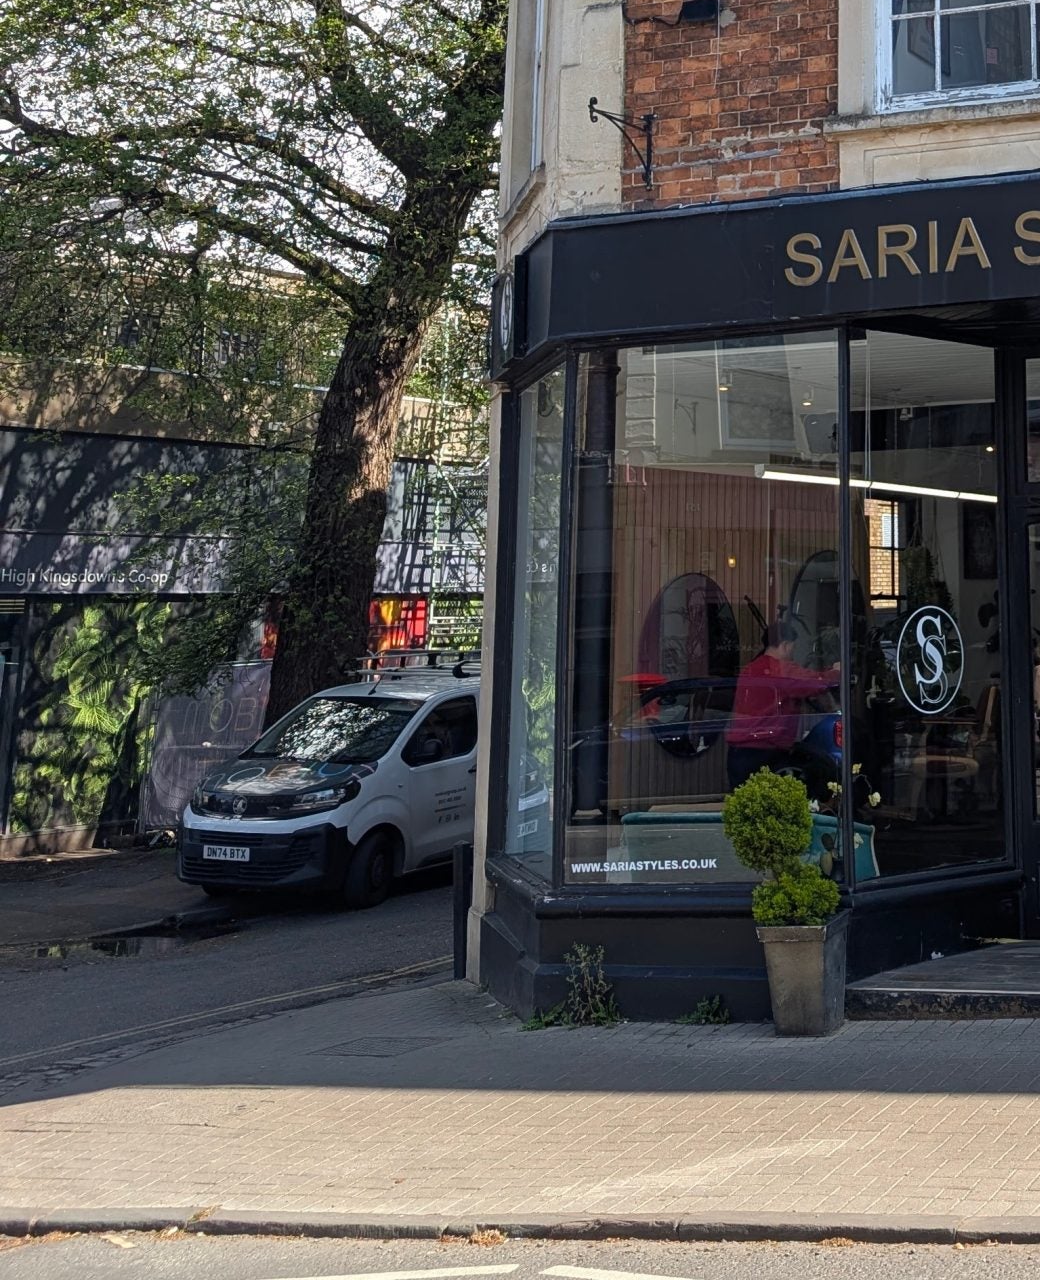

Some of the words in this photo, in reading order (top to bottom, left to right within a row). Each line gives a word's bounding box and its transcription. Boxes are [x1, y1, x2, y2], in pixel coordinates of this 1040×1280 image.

[784, 217, 992, 287] SARIA
[1, 568, 35, 586] High
[128, 569, 168, 587] Co-op
[207, 846, 228, 859] DN74
[229, 848, 247, 860] BTX
[571, 858, 718, 874] WWW.SARIASTYLES.CO.UK
